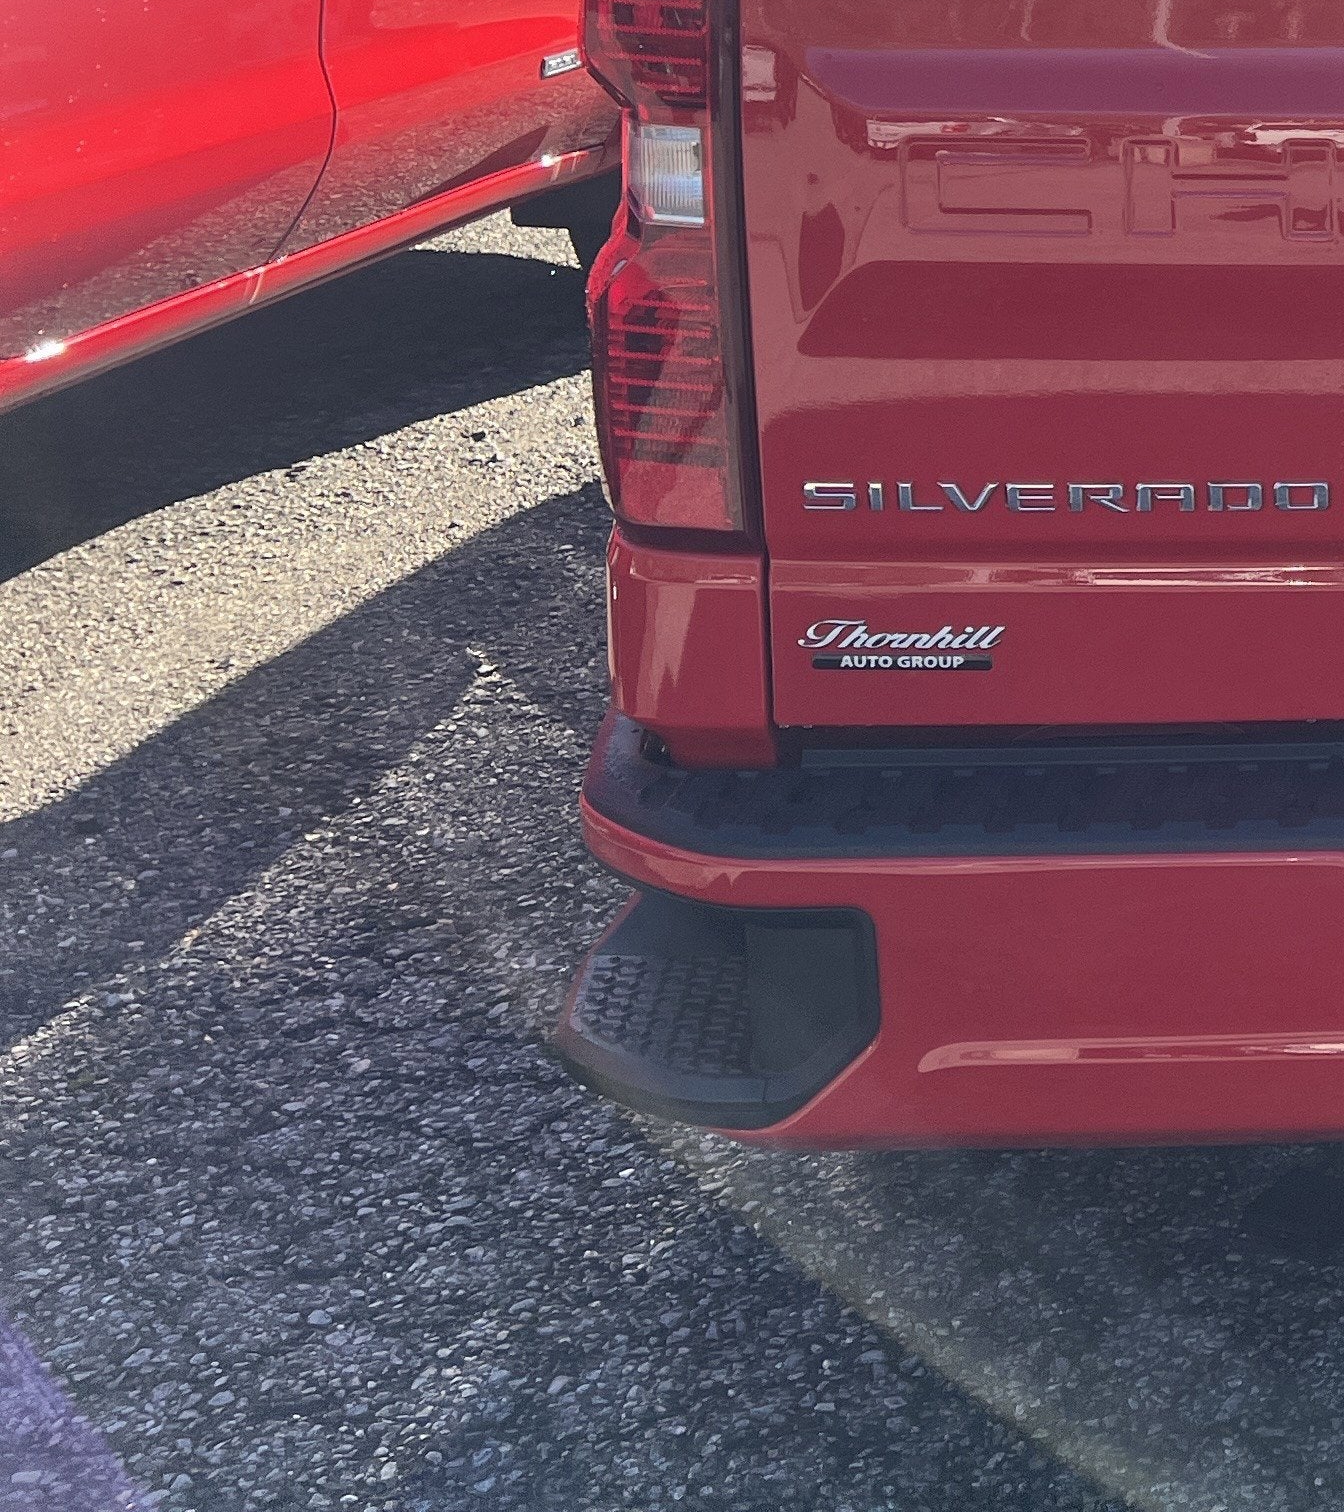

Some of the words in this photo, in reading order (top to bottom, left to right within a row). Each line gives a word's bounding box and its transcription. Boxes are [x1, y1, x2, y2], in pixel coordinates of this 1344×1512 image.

[803, 482, 1331, 514] SILVERADO
[797, 619, 1005, 649] Thornhill
[840, 655, 893, 669] AUTO
[897, 655, 965, 669] GROUP
